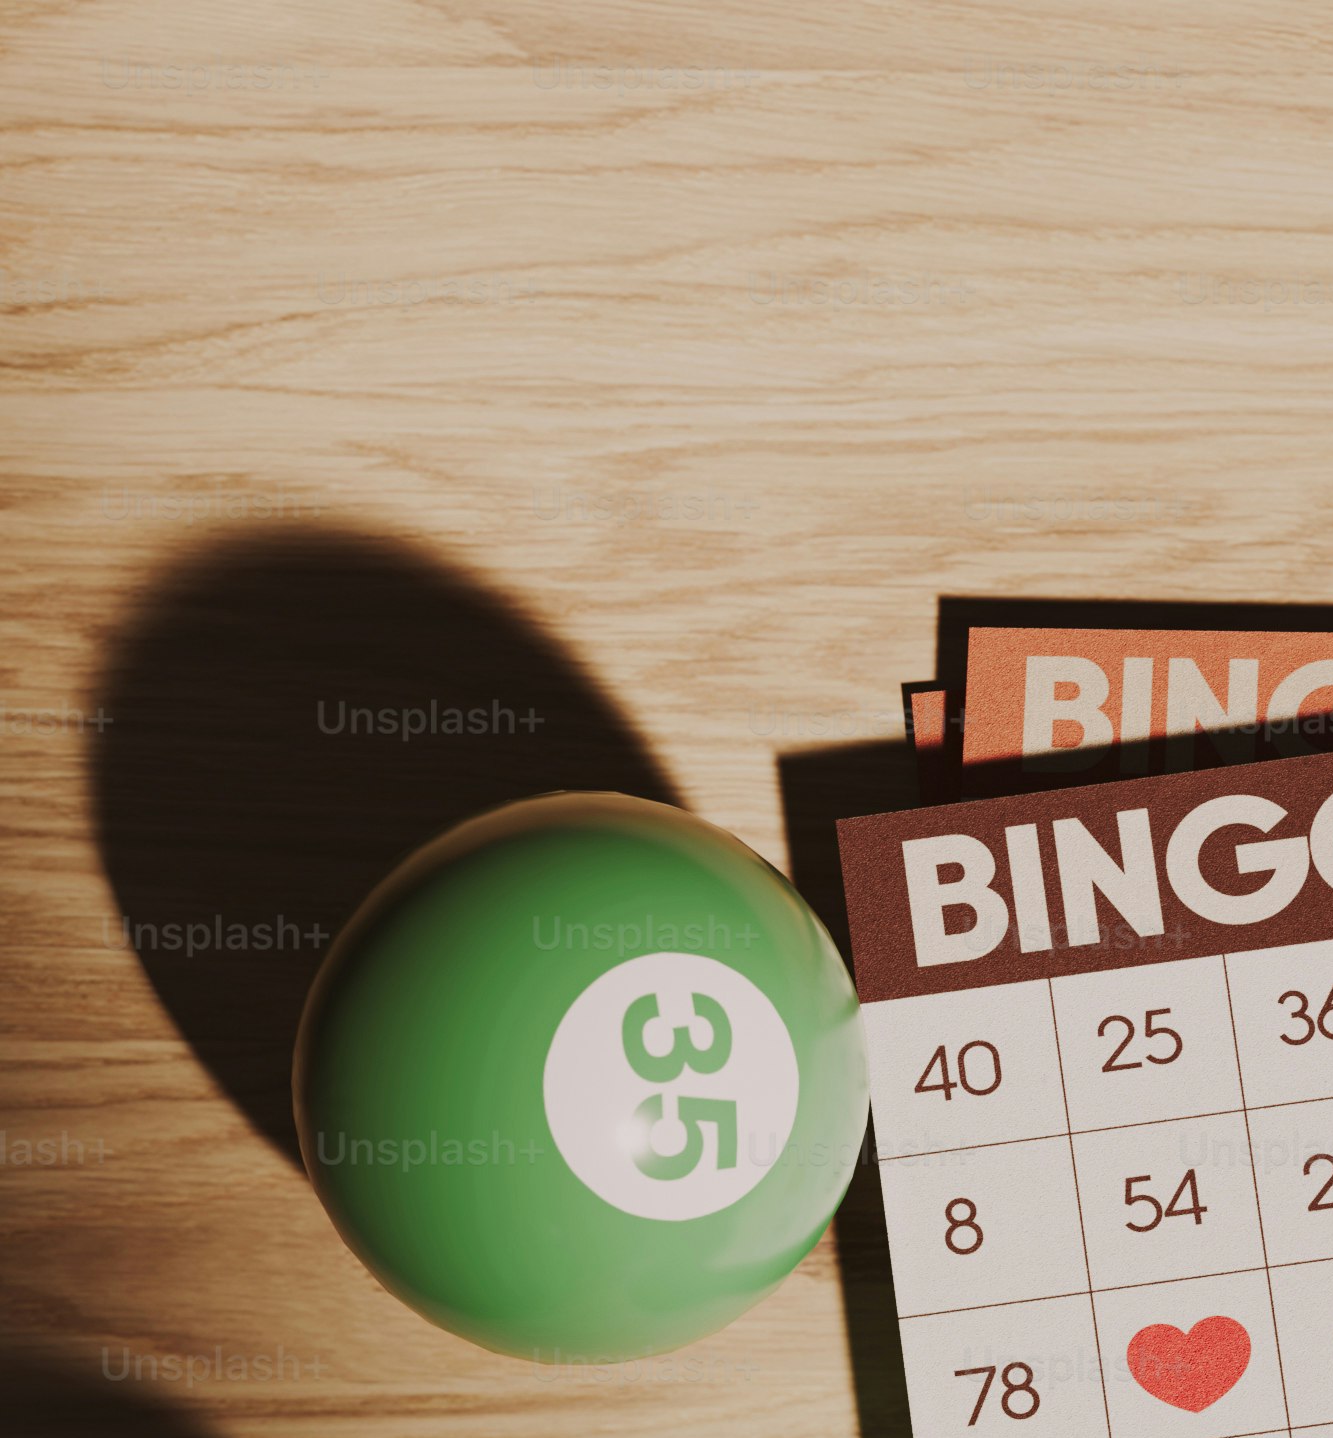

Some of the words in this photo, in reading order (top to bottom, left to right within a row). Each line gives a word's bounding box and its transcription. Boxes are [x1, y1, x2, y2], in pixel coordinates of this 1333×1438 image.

[621, 992, 738, 1182] 35
[914, 1040, 1002, 1101] 40
[1097, 1008, 1183, 1073] 25
[945, 1197, 984, 1255] 8
[1125, 1169, 1208, 1232] 54
[954, 1362, 1040, 1426] 78
